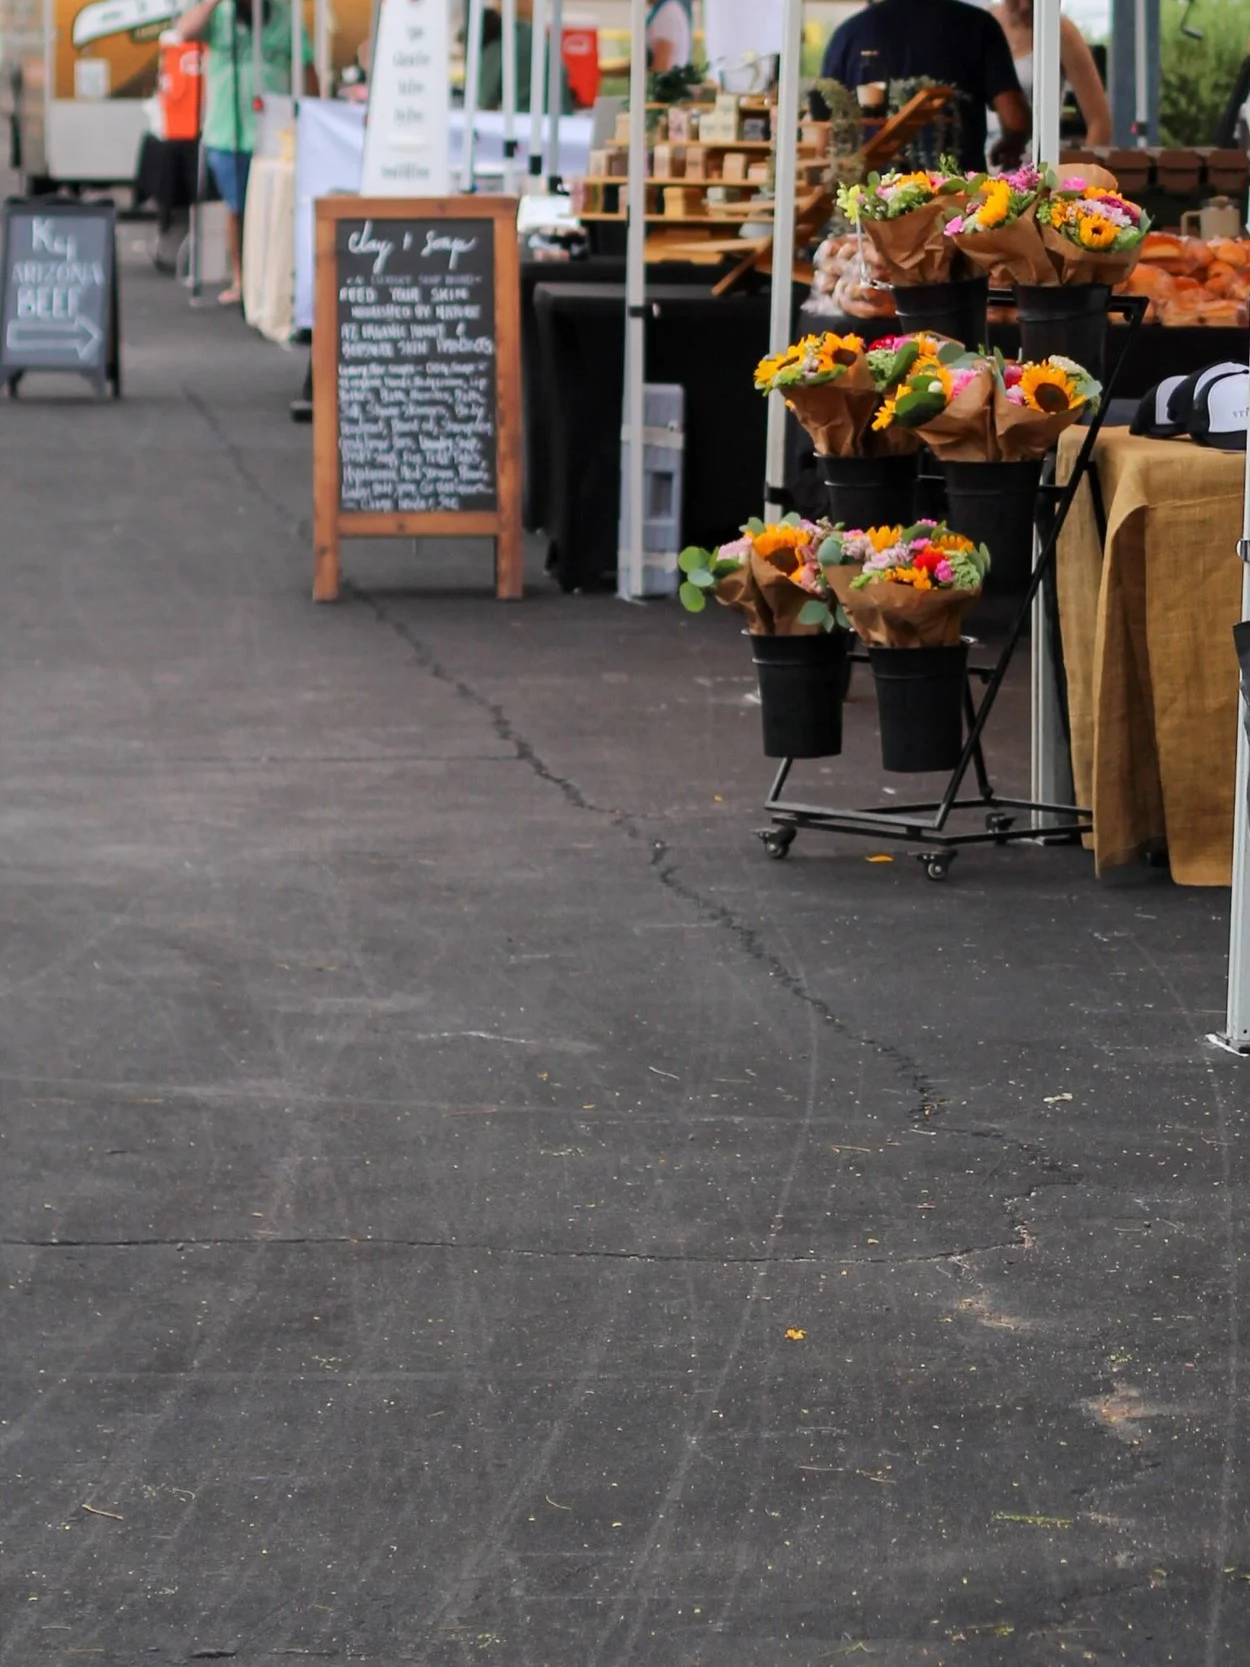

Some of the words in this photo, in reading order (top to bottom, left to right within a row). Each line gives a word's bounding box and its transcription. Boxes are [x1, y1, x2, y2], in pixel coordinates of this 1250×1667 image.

[421, 230, 478, 270] Soap
[12, 261, 104, 287] ARIZONA
[17, 284, 82, 318] BEEF
[339, 287, 377, 303] FEED
[389, 287, 420, 303] YOUR
[430, 287, 470, 302] SKIN
[414, 304, 432, 320] BY
[435, 304, 481, 320] NATURE
[397, 340, 428, 356] SKIN
